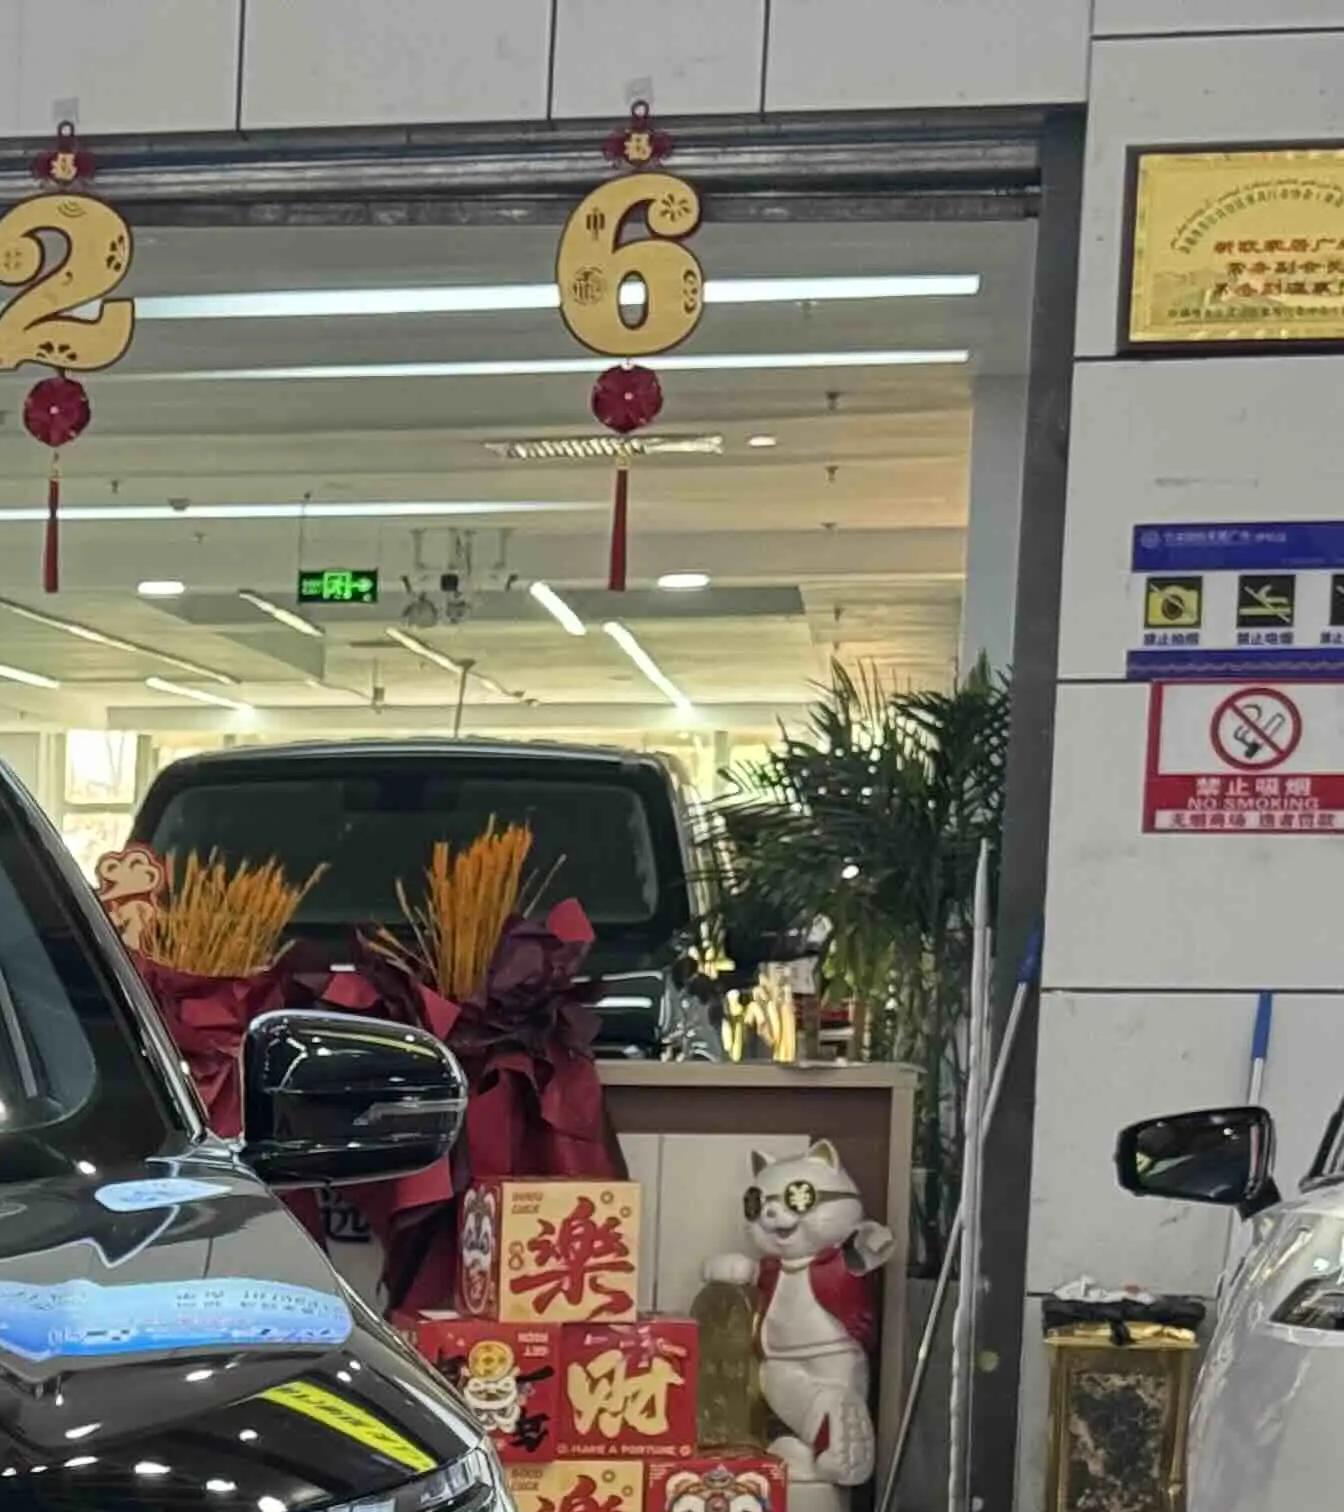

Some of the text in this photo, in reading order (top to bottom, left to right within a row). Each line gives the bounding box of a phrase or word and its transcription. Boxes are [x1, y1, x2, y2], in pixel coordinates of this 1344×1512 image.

[555, 171, 705, 357] 6
[1195, 777, 1312, 796] 禁止吸烟
[1187, 797, 1320, 811] NO SMOKING
